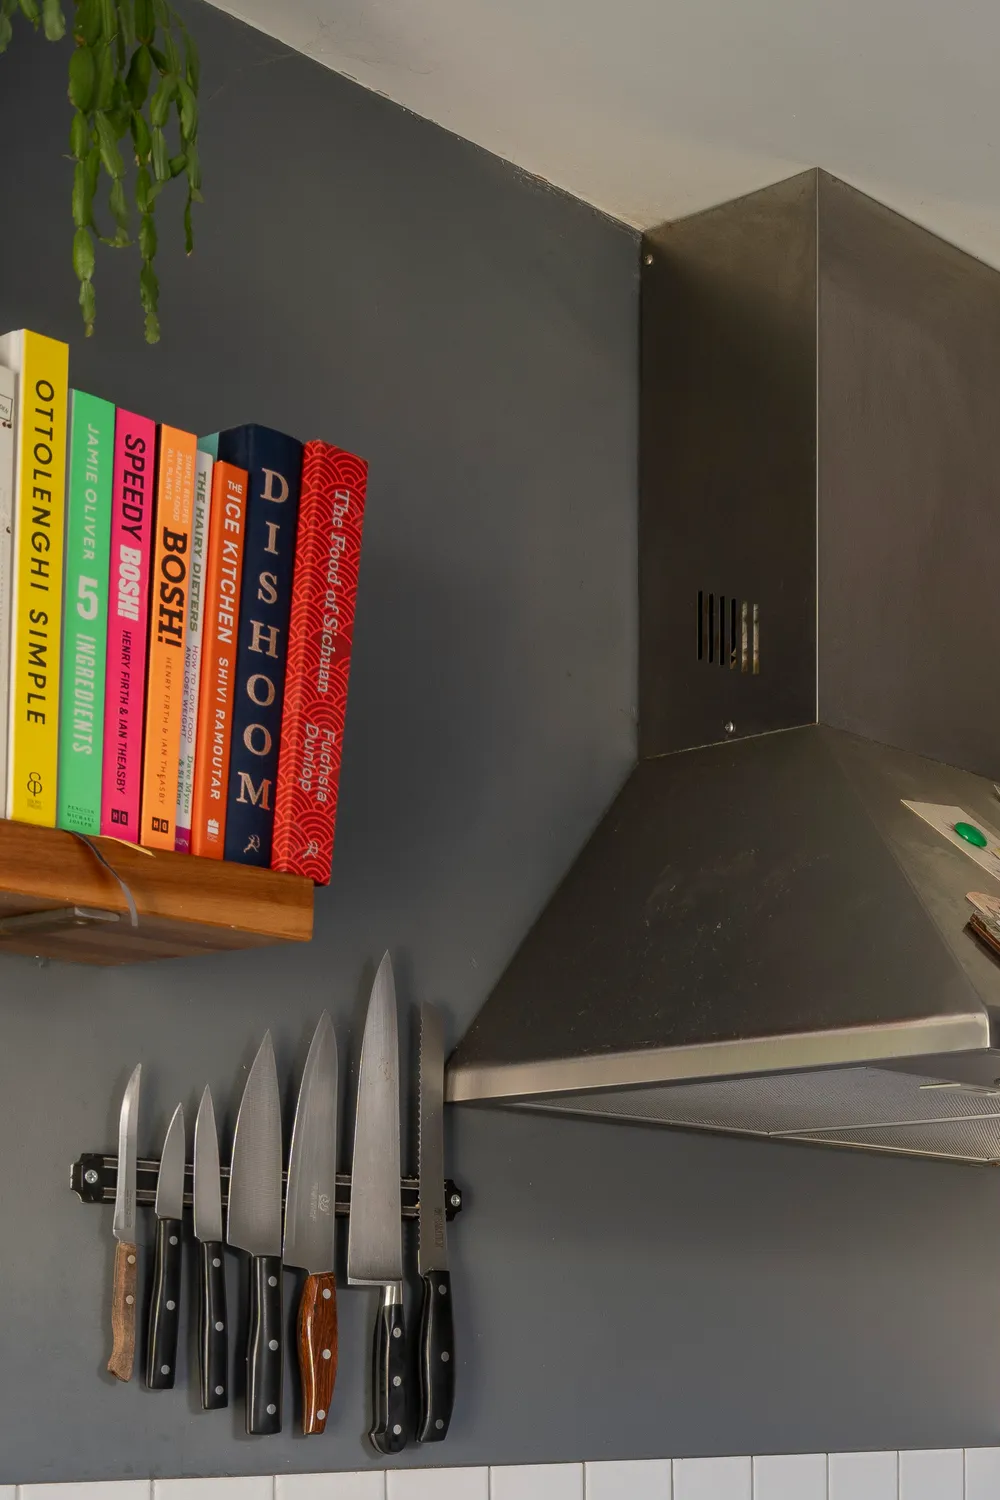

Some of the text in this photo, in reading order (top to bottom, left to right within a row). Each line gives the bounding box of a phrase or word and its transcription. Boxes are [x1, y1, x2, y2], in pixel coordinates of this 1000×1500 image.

[82, 424, 101, 561] JAMIE OLIVER
[117, 433, 146, 622] SPEEDY BOSH!
[164, 447, 175, 501] ALL PLANTS
[172, 450, 184, 522] AMAZING FOOD
[182, 453, 193, 525] SIMPLE RECIPES
[227, 480, 244, 494] THE
[26, 379, 55, 726] OTTOLENGHI SIMPLE
[157, 526, 188, 649] BOSH!
[189, 470, 207, 634] THE HAIRY DIETERS
[217, 494, 242, 644] ICE KITCHEN
[317, 489, 350, 693] The Food of Sichuan
[72, 575, 98, 755] 5 INGREDIENTS
[181, 645, 193, 738] AND LOSE WEIGHT
[186, 644, 198, 744] HOW TO LOVE FOOD
[236, 467, 289, 811] DISHOOM
[116, 629, 132, 795] HENRY FIRTH & IAN THEASBY
[163, 694, 171, 723] FIRTH
[209, 656, 229, 800] SHIVI RAMOUTAR
[298, 723, 319, 793] Dunlop
[158, 758, 168, 806] THEASBY
[183, 754, 194, 815] Dave Myers
[316, 727, 336, 803] Fuchsia
